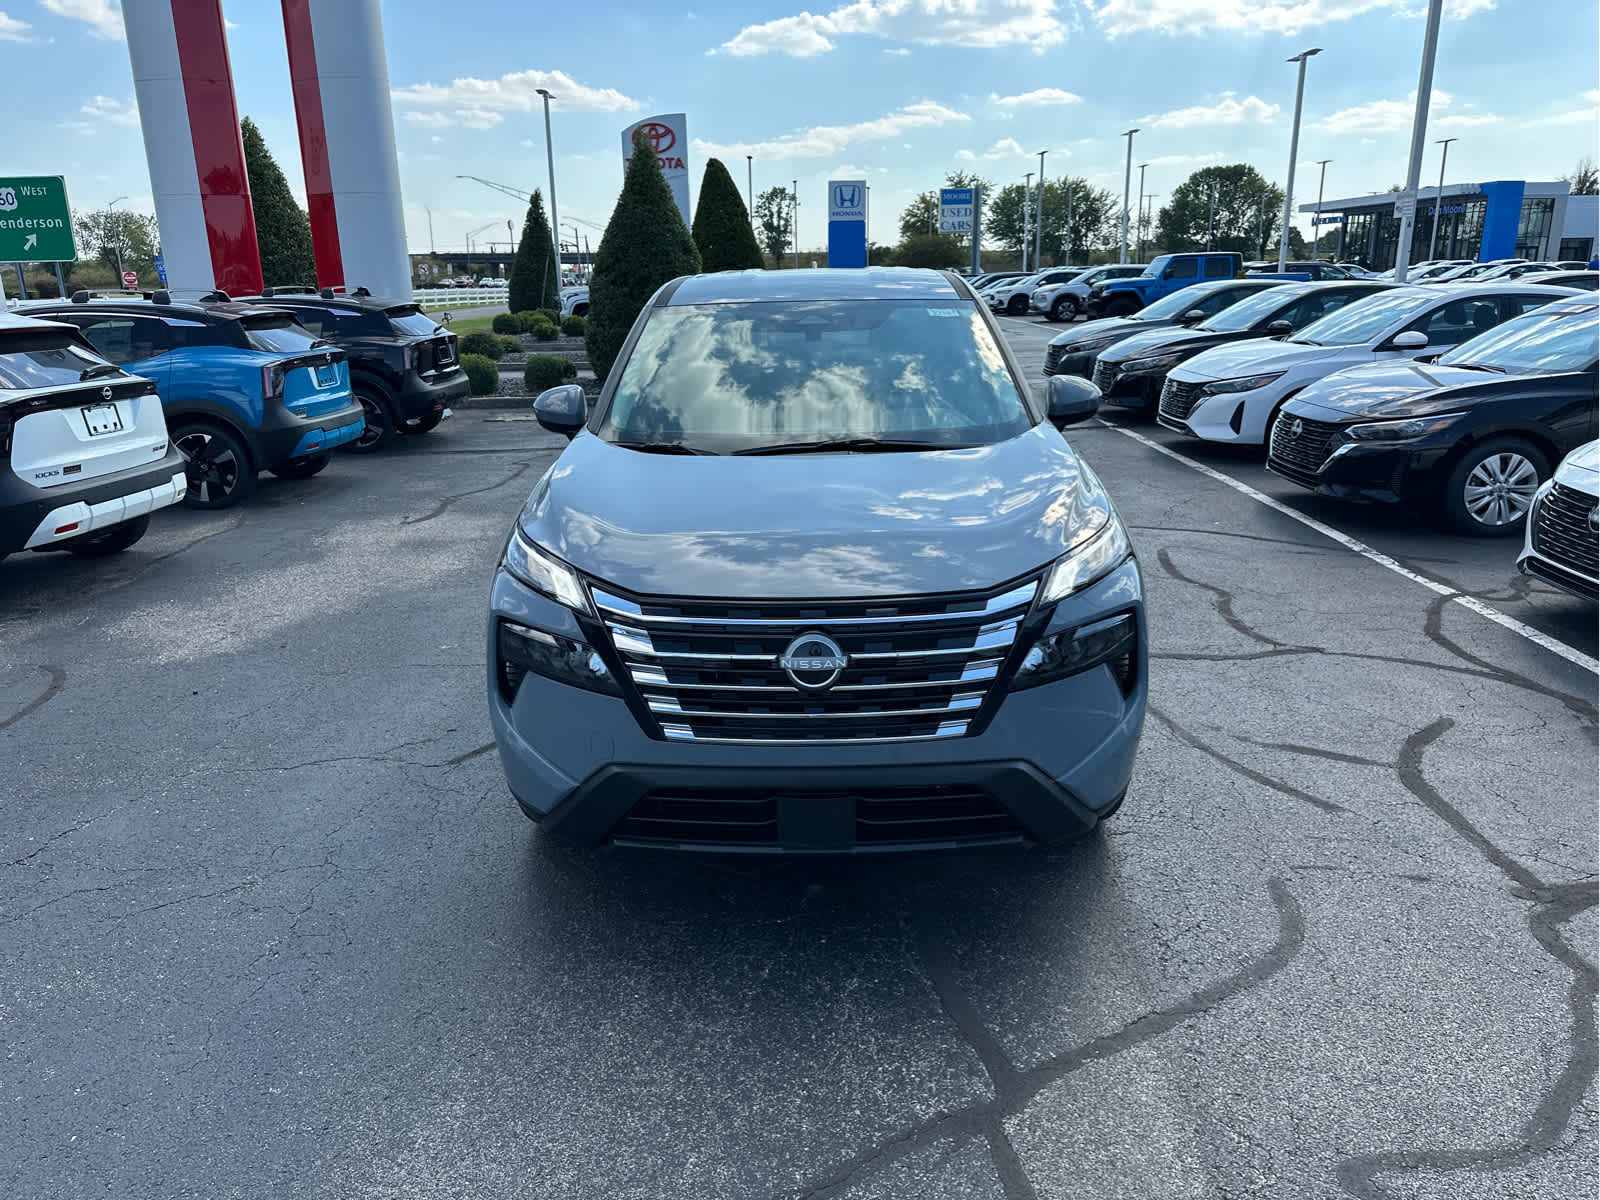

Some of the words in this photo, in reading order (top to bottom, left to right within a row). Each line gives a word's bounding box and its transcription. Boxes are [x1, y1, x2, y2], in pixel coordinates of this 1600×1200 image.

[20, 186, 47, 196] WEST
[942, 207, 972, 217] USED
[0, 217, 63, 229] enderson
[941, 220, 972, 231] CARS
[35, 470, 60, 479] KICKS
[780, 659, 847, 670] NISSAN
